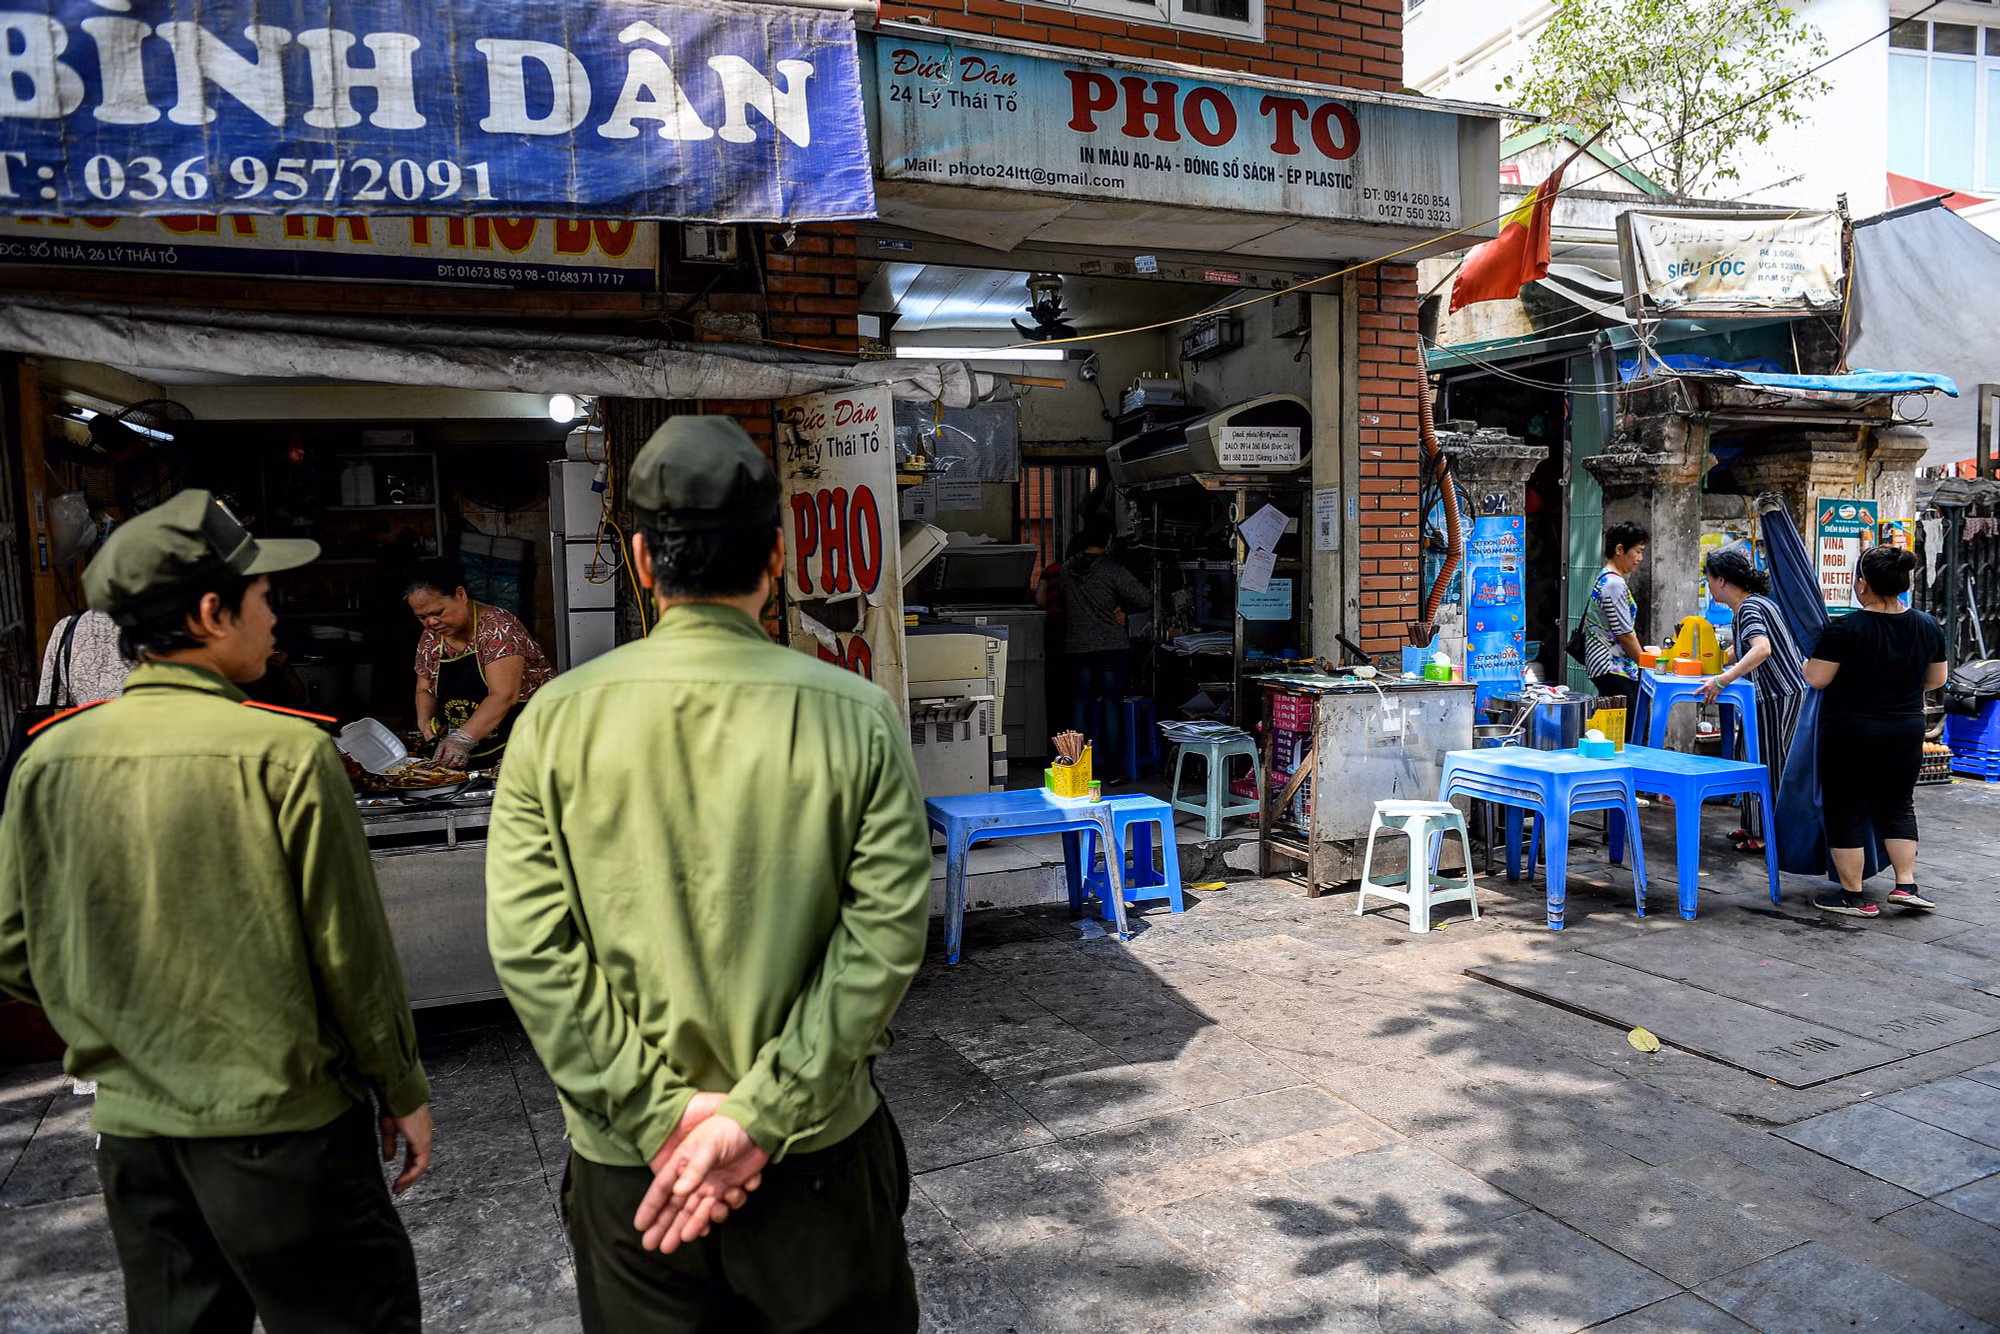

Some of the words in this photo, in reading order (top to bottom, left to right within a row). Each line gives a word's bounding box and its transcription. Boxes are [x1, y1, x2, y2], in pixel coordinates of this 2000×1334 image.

[474, 20, 815, 148] DÂN
[959, 56, 1017, 87] Dân
[890, 85, 912, 103] 24
[919, 87, 942, 109] Lý
[947, 90, 988, 110] Thái
[993, 90, 1017, 112] Tổ
[1064, 69, 1238, 147] PHO
[1258, 95, 1361, 160] TO
[84, 155, 209, 200] 036
[229, 156, 498, 201] 9572091
[904, 158, 943, 174] Mail:
[948, 161, 1125, 189] photo24ltt@gmail.com
[1080, 146, 1094, 164] IN
[1099, 145, 1129, 167] MÀU
[1184, 154, 1219, 177] ĐÓNG
[1222, 157, 1239, 178] SỔ
[1243, 161, 1275, 183] SÁCH
[1287, 166, 1302, 185] ÉP
[1306, 170, 1352, 190] PLASTIC
[1363, 188, 1381, 201] ĐT:
[1383, 190, 1408, 204] 0914
[1411, 193, 1429, 206] 260
[1432, 195, 1450, 208] 854
[1378, 204, 1402, 217] 0127
[1406, 207, 1424, 220] 550
[1427, 210, 1451, 222] 3323
[29, 242, 50, 257] SỐ
[54, 246, 85, 260] NHÀ
[89, 249, 105, 261] 26
[108, 247, 122, 262] LÝ
[125, 249, 156, 263] THÁI
[158, 247, 178, 264] TỔ
[1668, 258, 1701, 279] SIÊU
[1707, 254, 1745, 276] TỐC
[437, 265, 455, 277] ĐT:
[457, 266, 491, 279] 01673
[493, 267, 507, 280] 85
[509, 268, 523, 280] 93
[525, 269, 539, 281] 98
[547, 270, 579, 283] 01683
[582, 271, 593, 284] 71
[598, 273, 610, 284] 17
[613, 274, 624, 285] 17
[834, 400, 878, 429] Dân
[826, 435, 856, 458] Thái
[860, 423, 879, 454] Tổ
[1225, 442, 1239, 450] ZALO:
[1482, 493, 1507, 514] 24
[790, 484, 882, 595] PHO
[1823, 537, 1844, 550] VINA
[1823, 554, 1846, 567] MOBI
